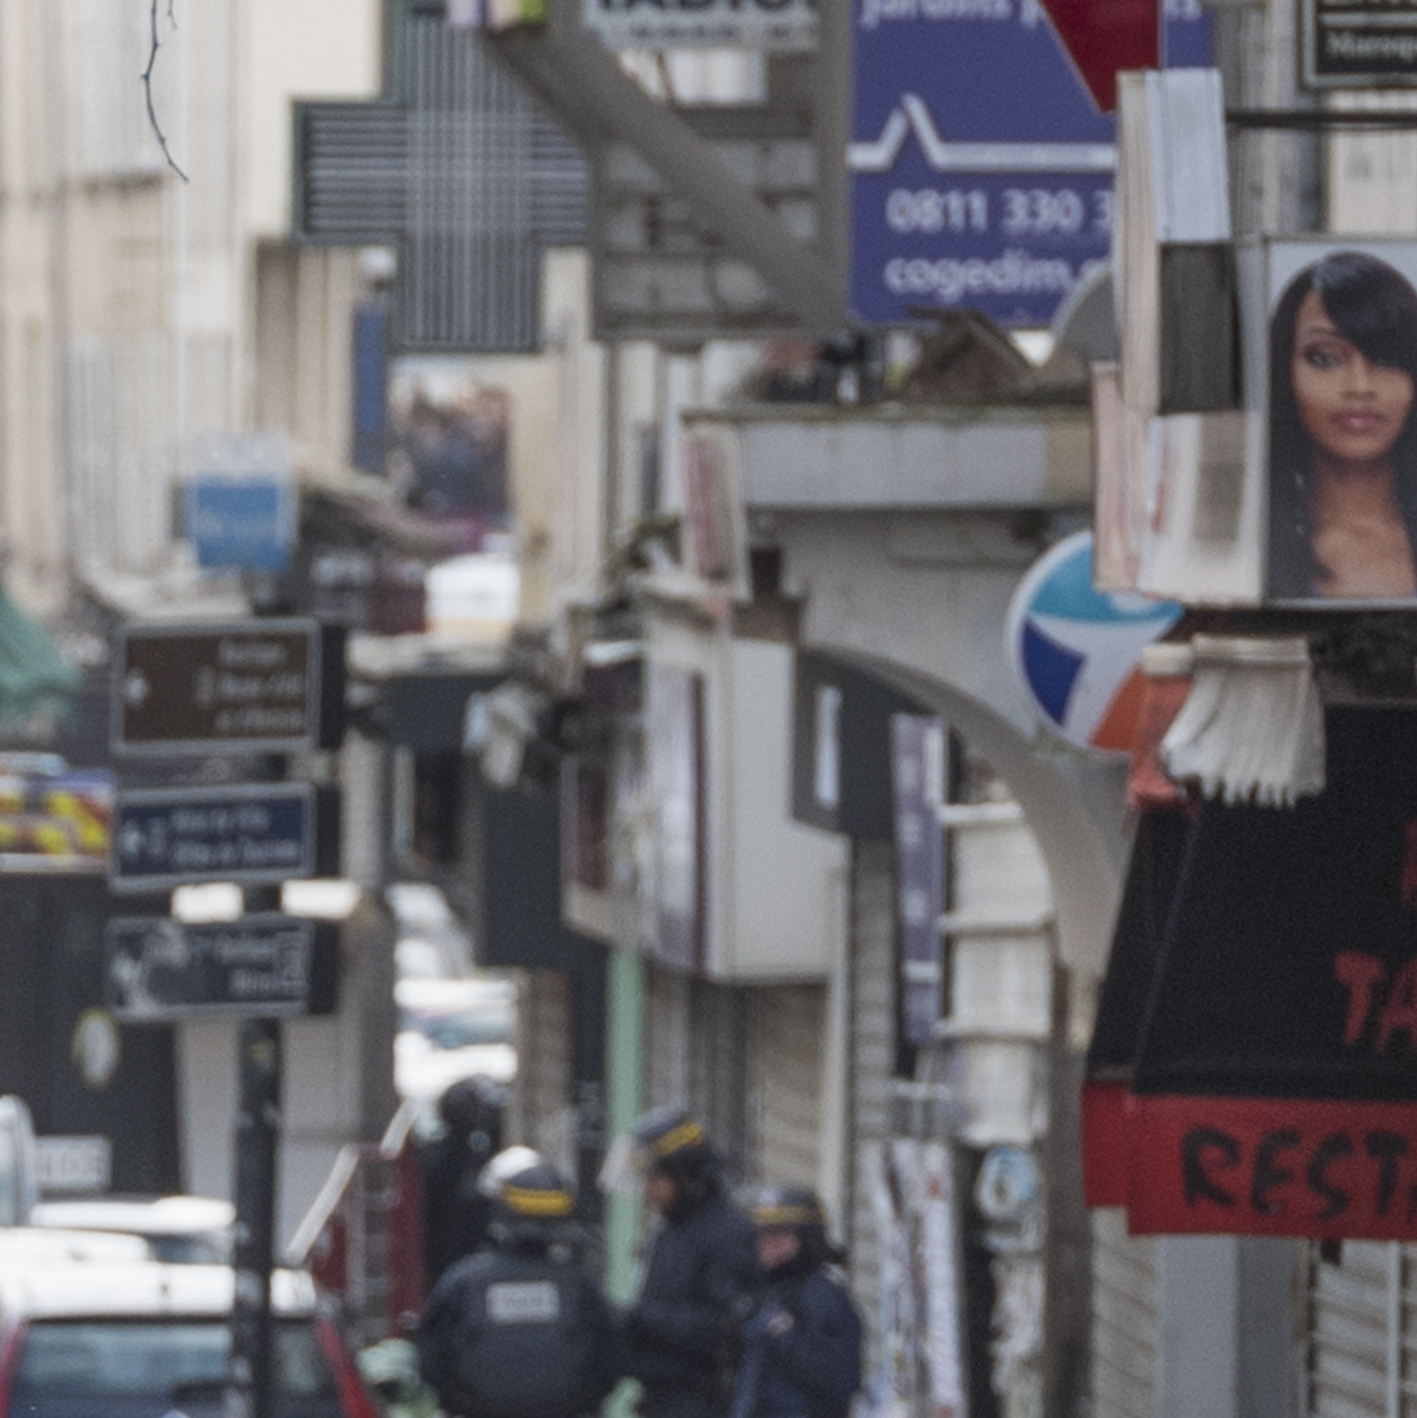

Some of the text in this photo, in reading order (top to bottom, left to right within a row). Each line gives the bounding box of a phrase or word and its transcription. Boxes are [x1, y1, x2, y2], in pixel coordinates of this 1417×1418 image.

[883, 188, 1113, 235] 0811 330 3
[1333, 948, 1417, 1055] TA
[1180, 1125, 1417, 1224] REST
